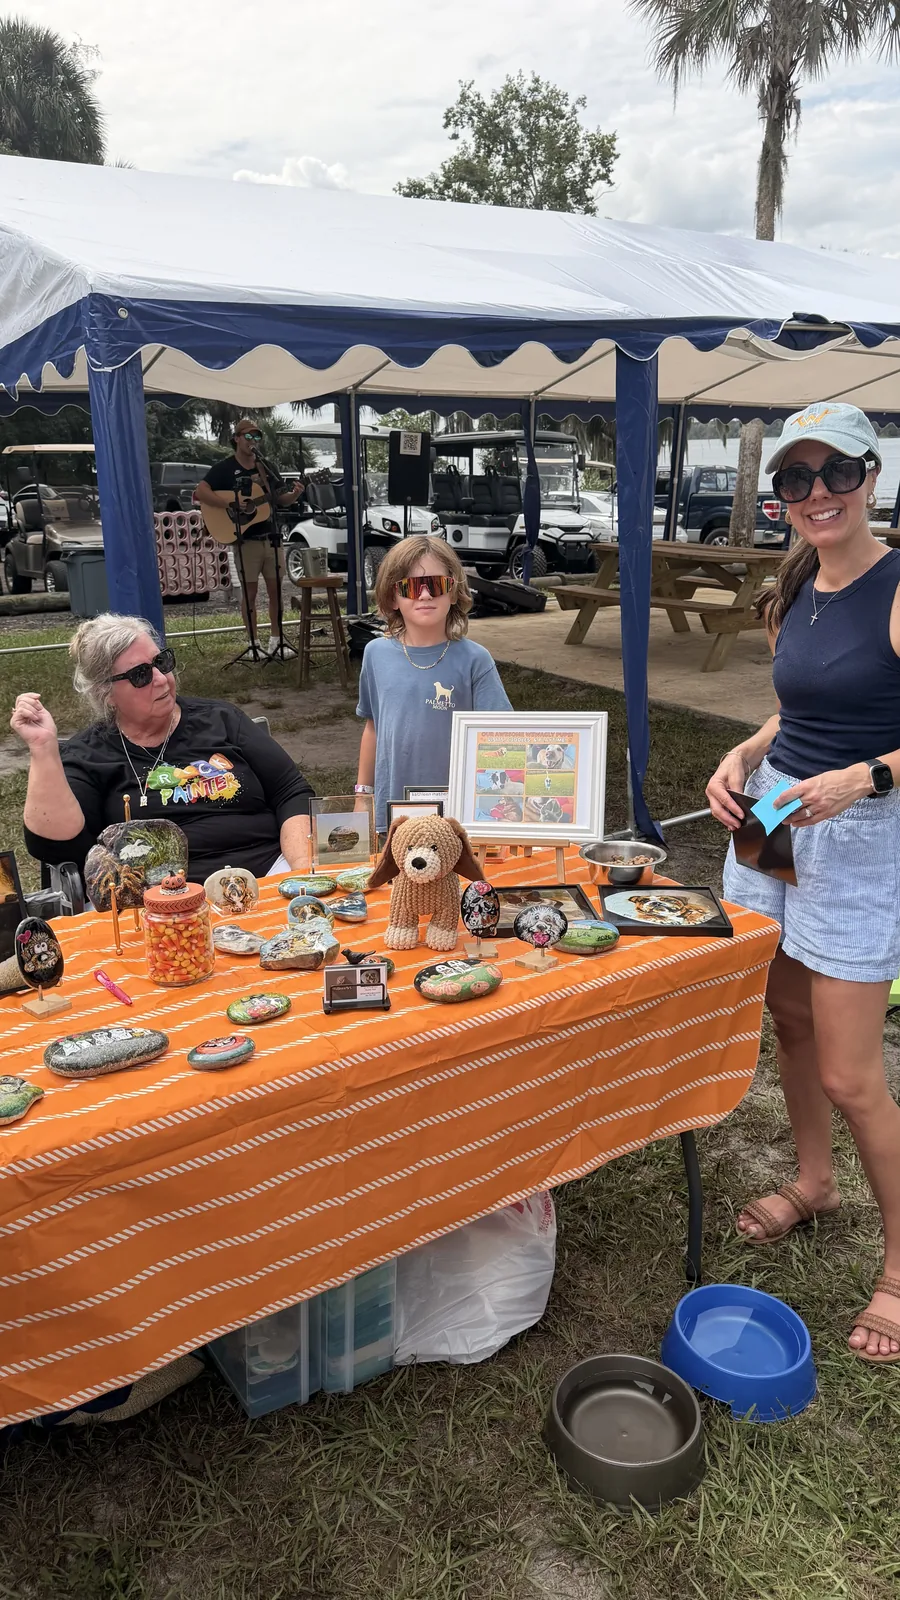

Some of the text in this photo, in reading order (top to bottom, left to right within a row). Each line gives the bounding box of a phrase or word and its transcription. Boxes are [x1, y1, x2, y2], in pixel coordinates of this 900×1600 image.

[425, 698, 456, 708] PALMETTO
[432, 703, 448, 711] MOON
[159, 772, 241, 806] PAINTER
